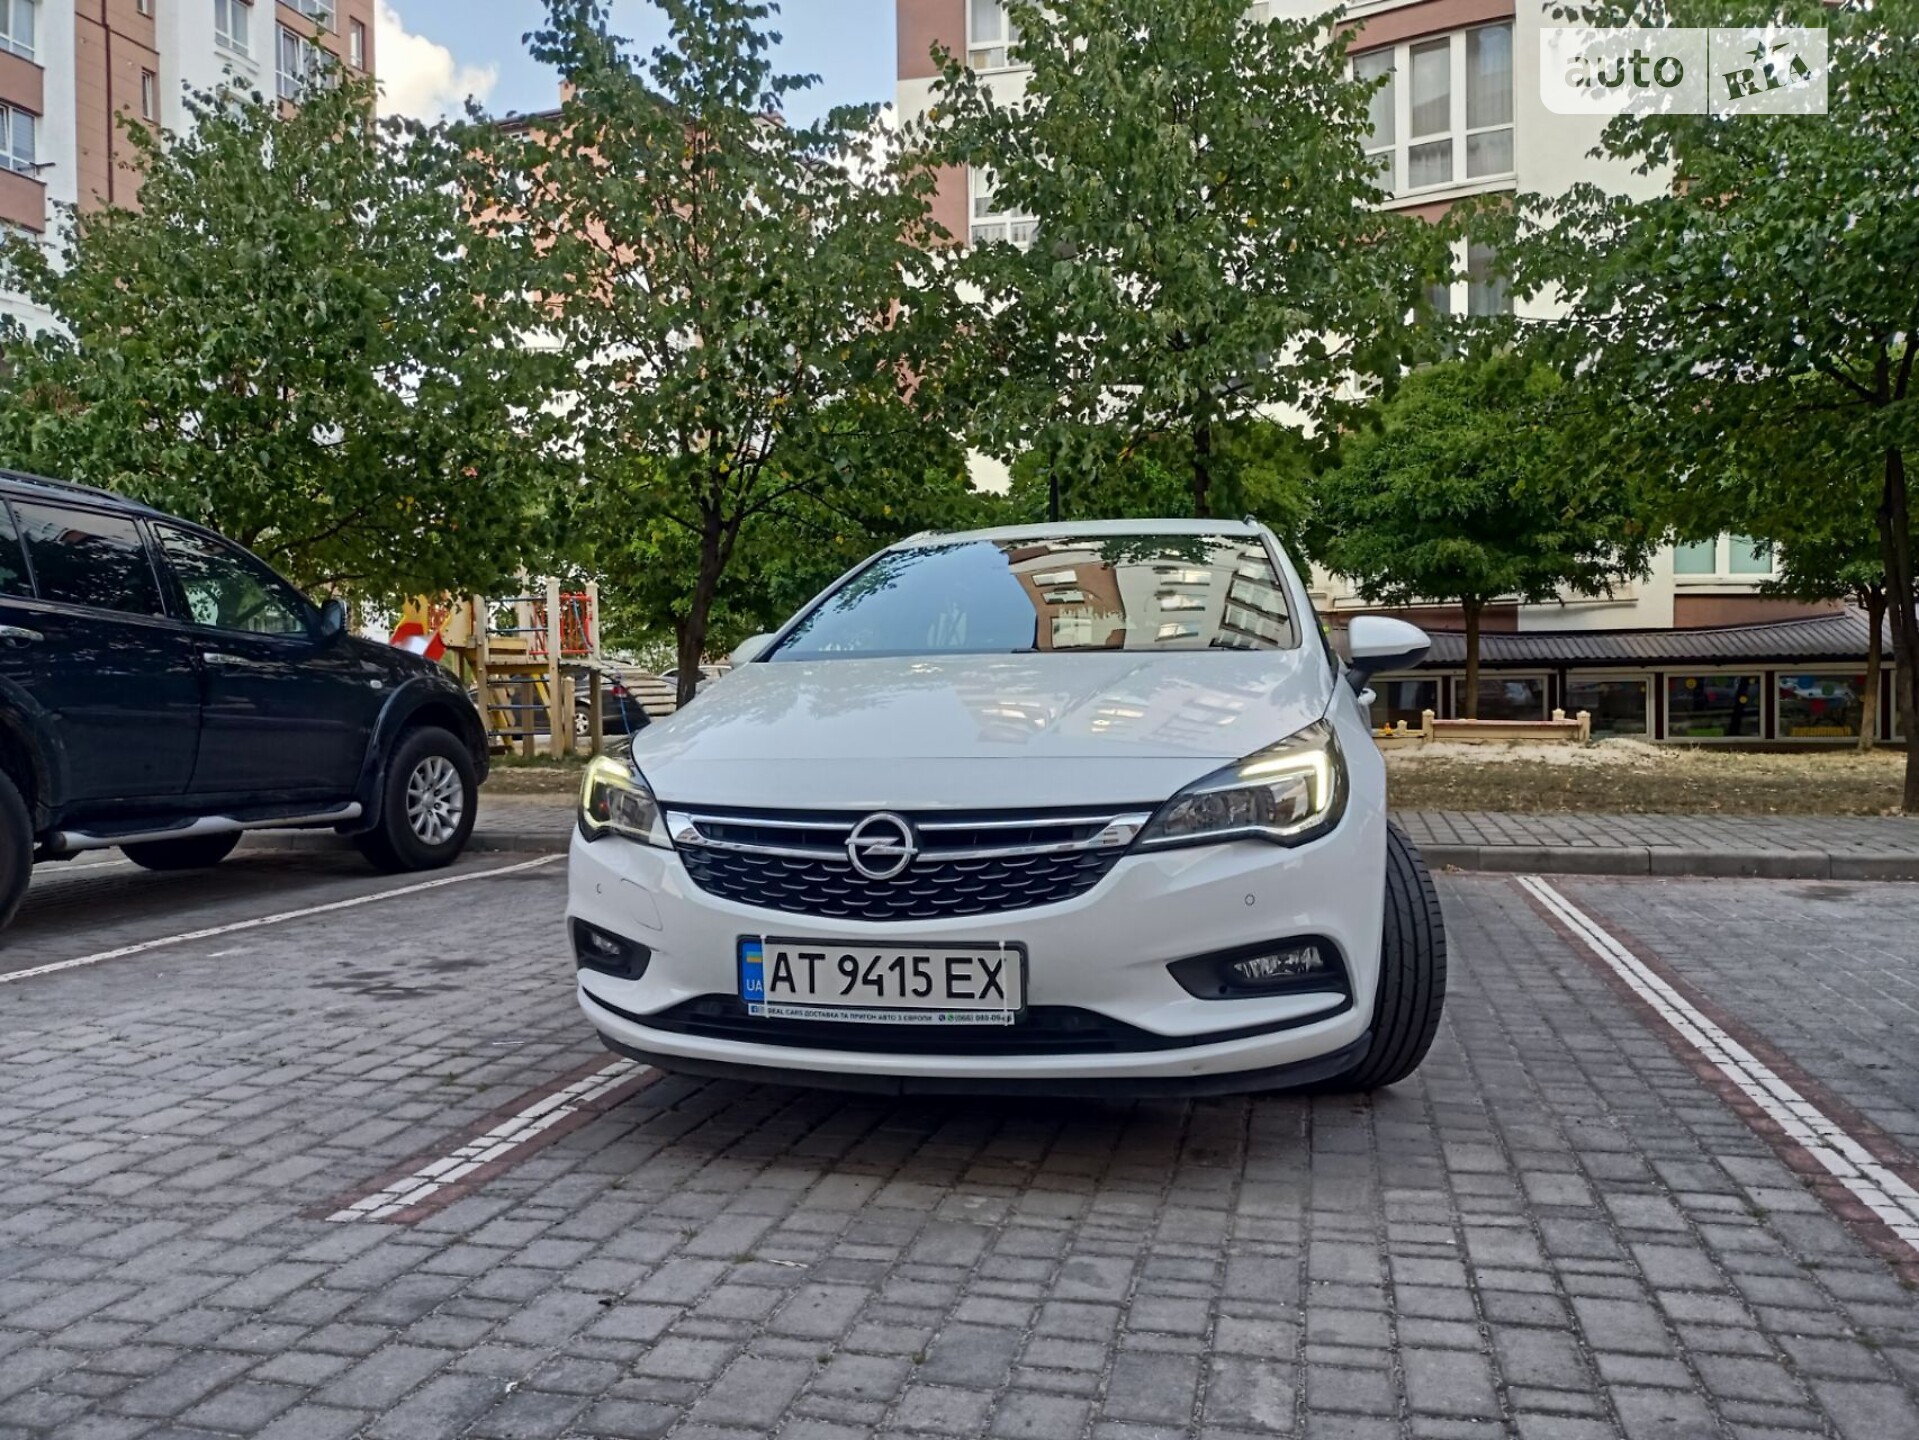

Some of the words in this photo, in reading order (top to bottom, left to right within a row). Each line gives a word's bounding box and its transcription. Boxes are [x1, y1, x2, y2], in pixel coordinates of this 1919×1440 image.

[770, 952, 826, 994] AT
[837, 954, 933, 997] 9415
[945, 956, 1007, 1000] EX
[746, 979, 764, 993] UA
[804, 1010, 839, 1018] ДОСТАВКА
